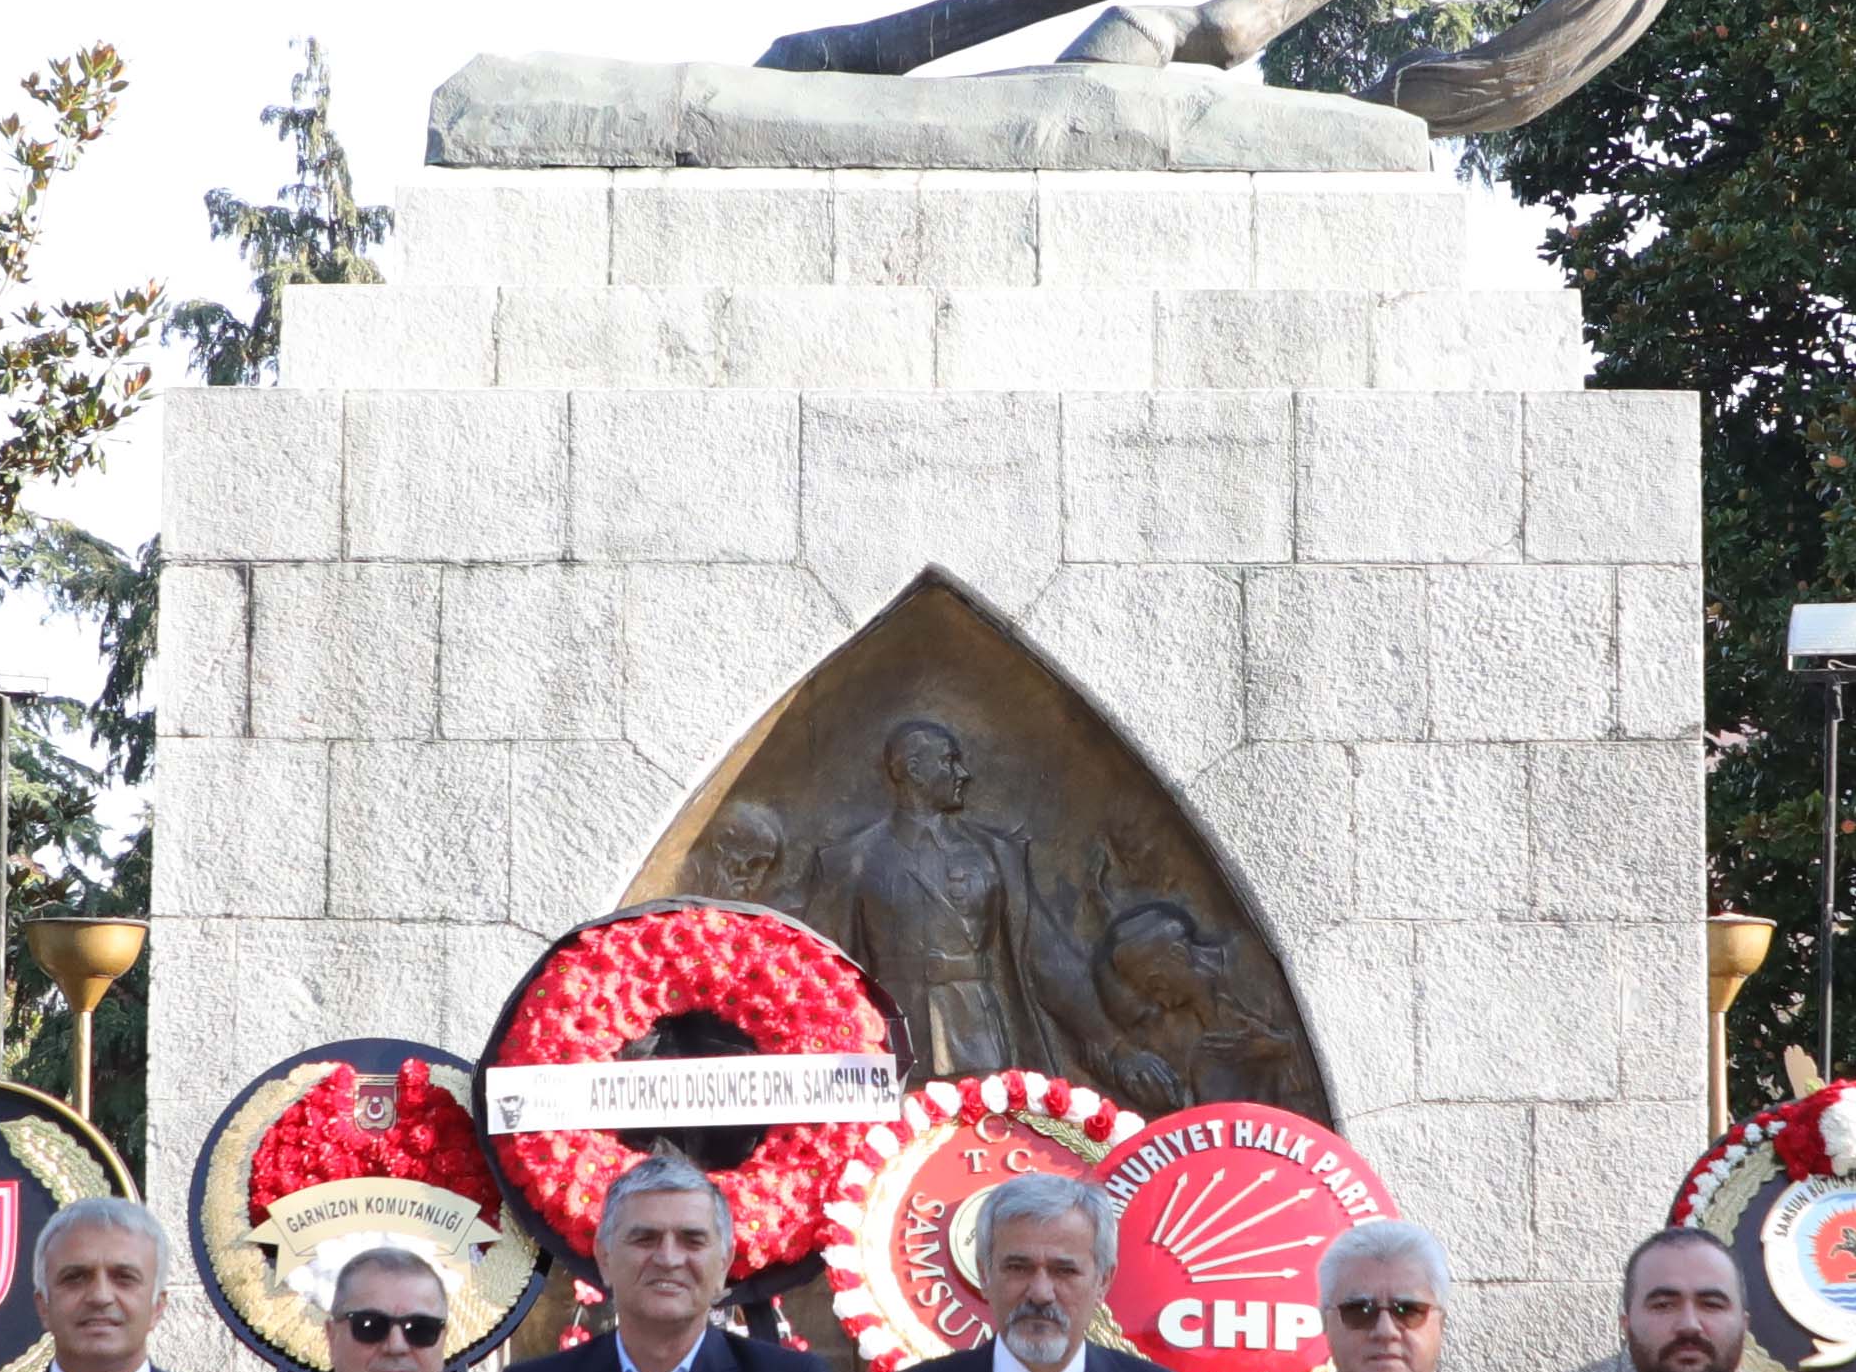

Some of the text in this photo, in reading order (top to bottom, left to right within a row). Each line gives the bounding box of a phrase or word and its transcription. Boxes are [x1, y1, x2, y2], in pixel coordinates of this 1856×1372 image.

[589, 1067, 681, 1117] ATATÜRKÇÜ
[686, 1065, 757, 1116] DÜŞÜNCE
[763, 1068, 799, 1109] DRN.
[804, 1067, 866, 1106] SAMSUN
[1106, 1119, 1387, 1227] HURİYET HALK PARTİ
[286, 1195, 464, 1234] GARNİZON KOMUTANLIĞI
[1773, 1191, 1810, 1237] SAMSUN
[1158, 1298, 1324, 1351] CHP
